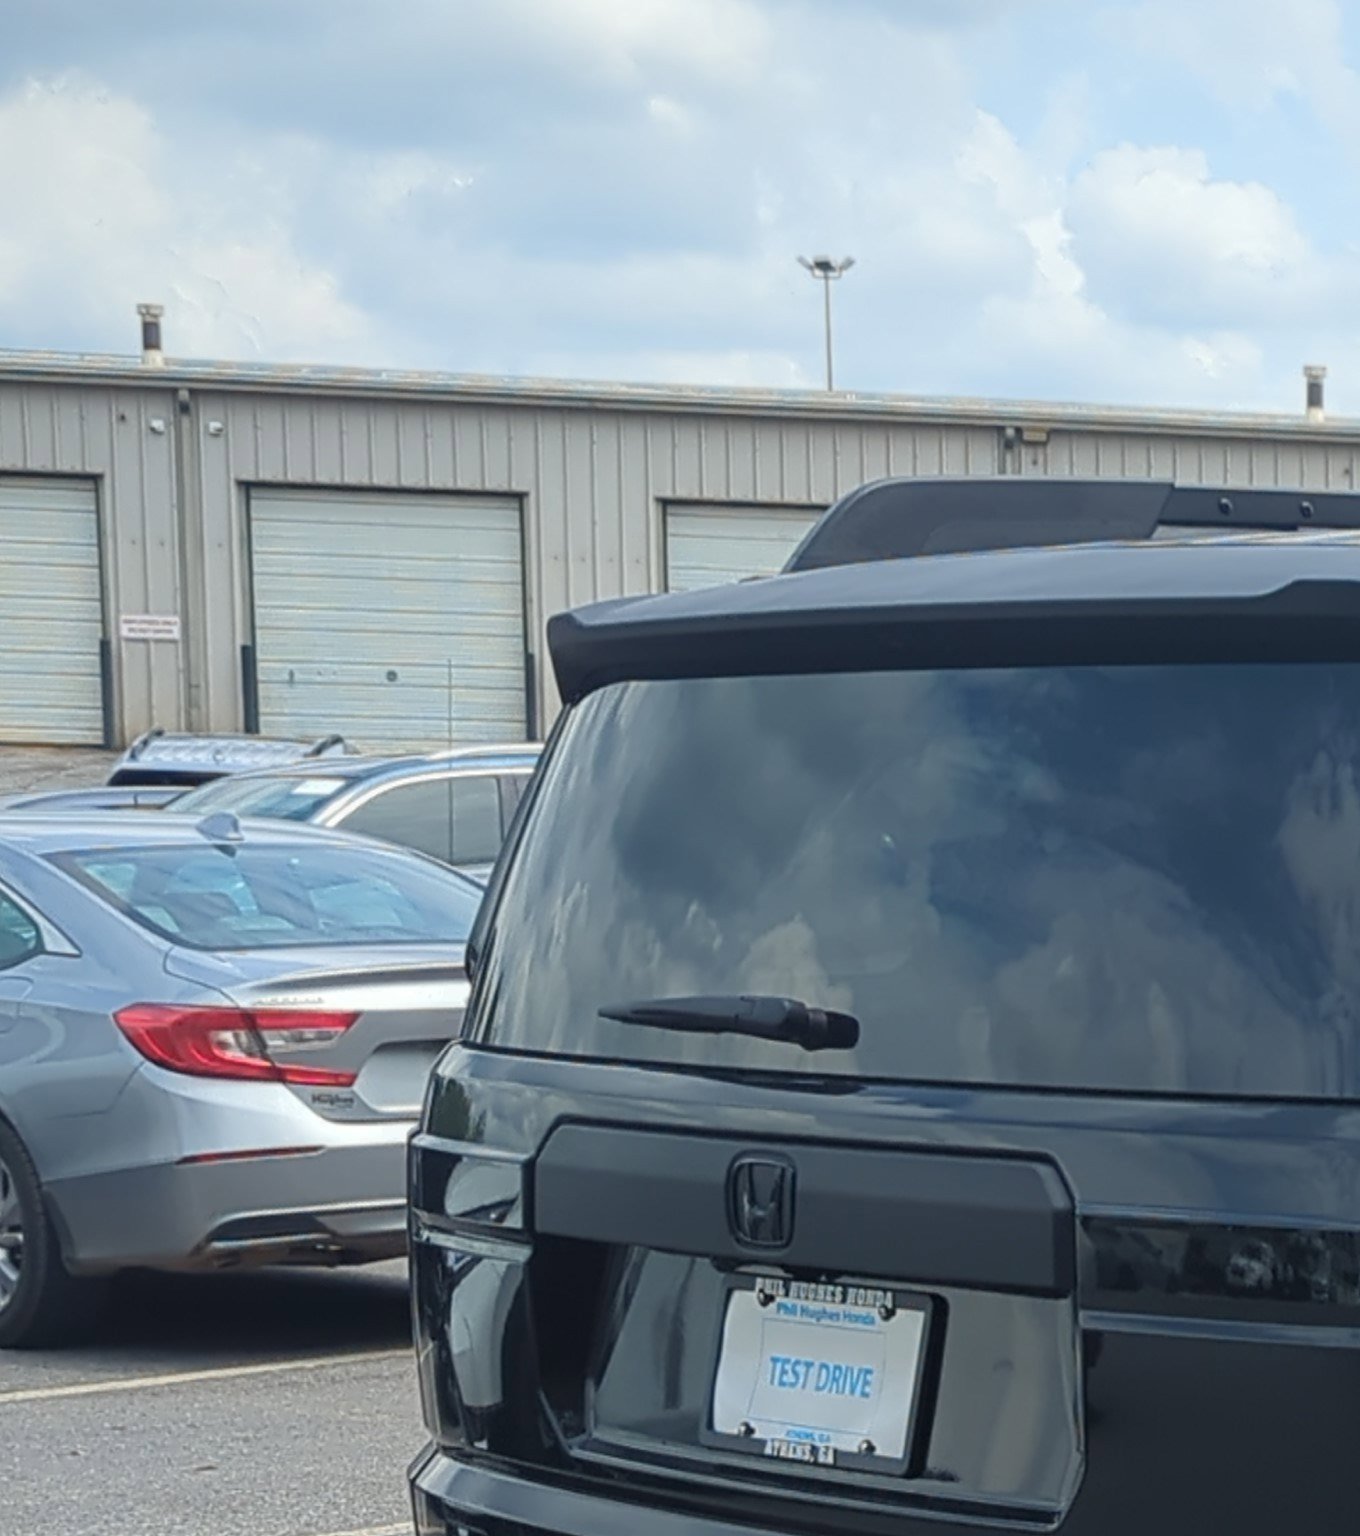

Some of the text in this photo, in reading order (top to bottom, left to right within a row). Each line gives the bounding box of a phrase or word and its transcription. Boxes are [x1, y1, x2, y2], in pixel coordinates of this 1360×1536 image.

[788, 1281, 843, 1304] HUGHES
[846, 1287, 893, 1311] HONDA
[769, 1355, 874, 1399] TEST DRIVE
